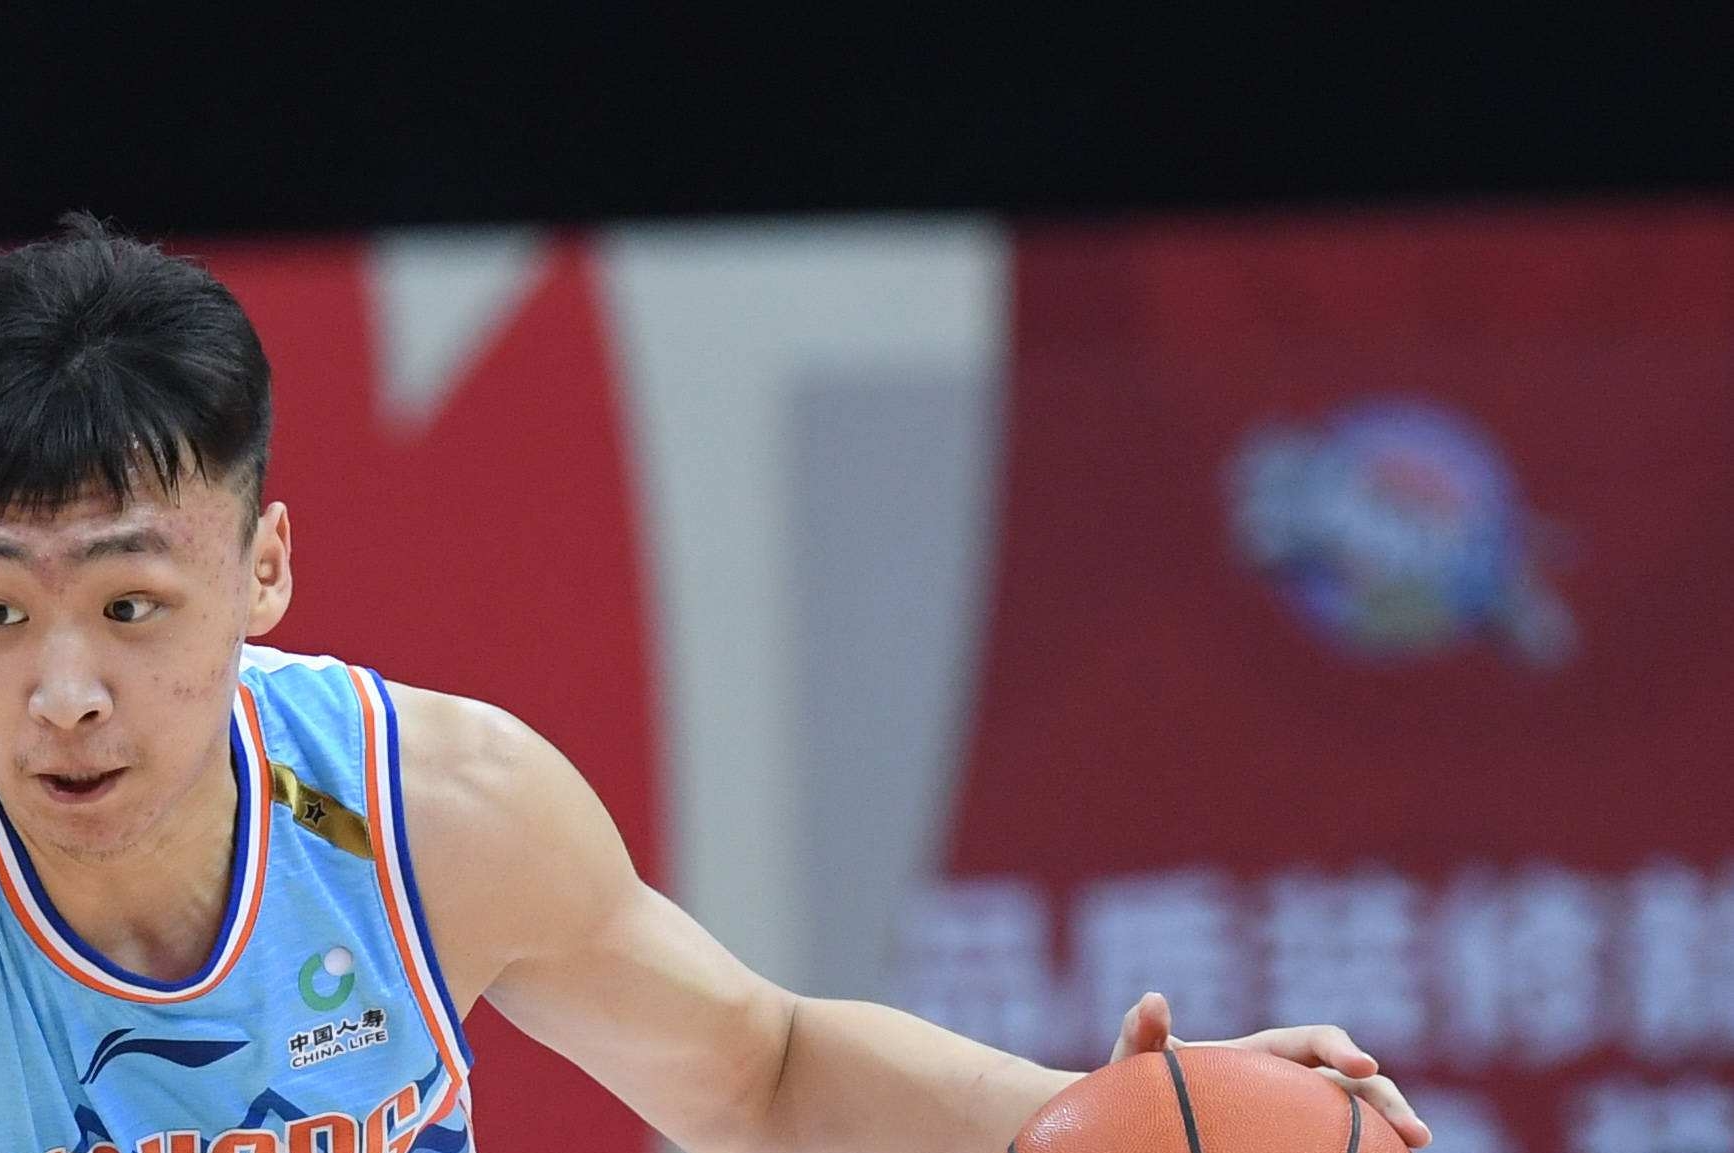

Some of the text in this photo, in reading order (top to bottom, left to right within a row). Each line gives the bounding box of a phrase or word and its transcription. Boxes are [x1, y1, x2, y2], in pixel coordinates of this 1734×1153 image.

[289, 1008, 385, 1053] 中国人寿
[291, 1029, 387, 1068] CHINA LIFE
